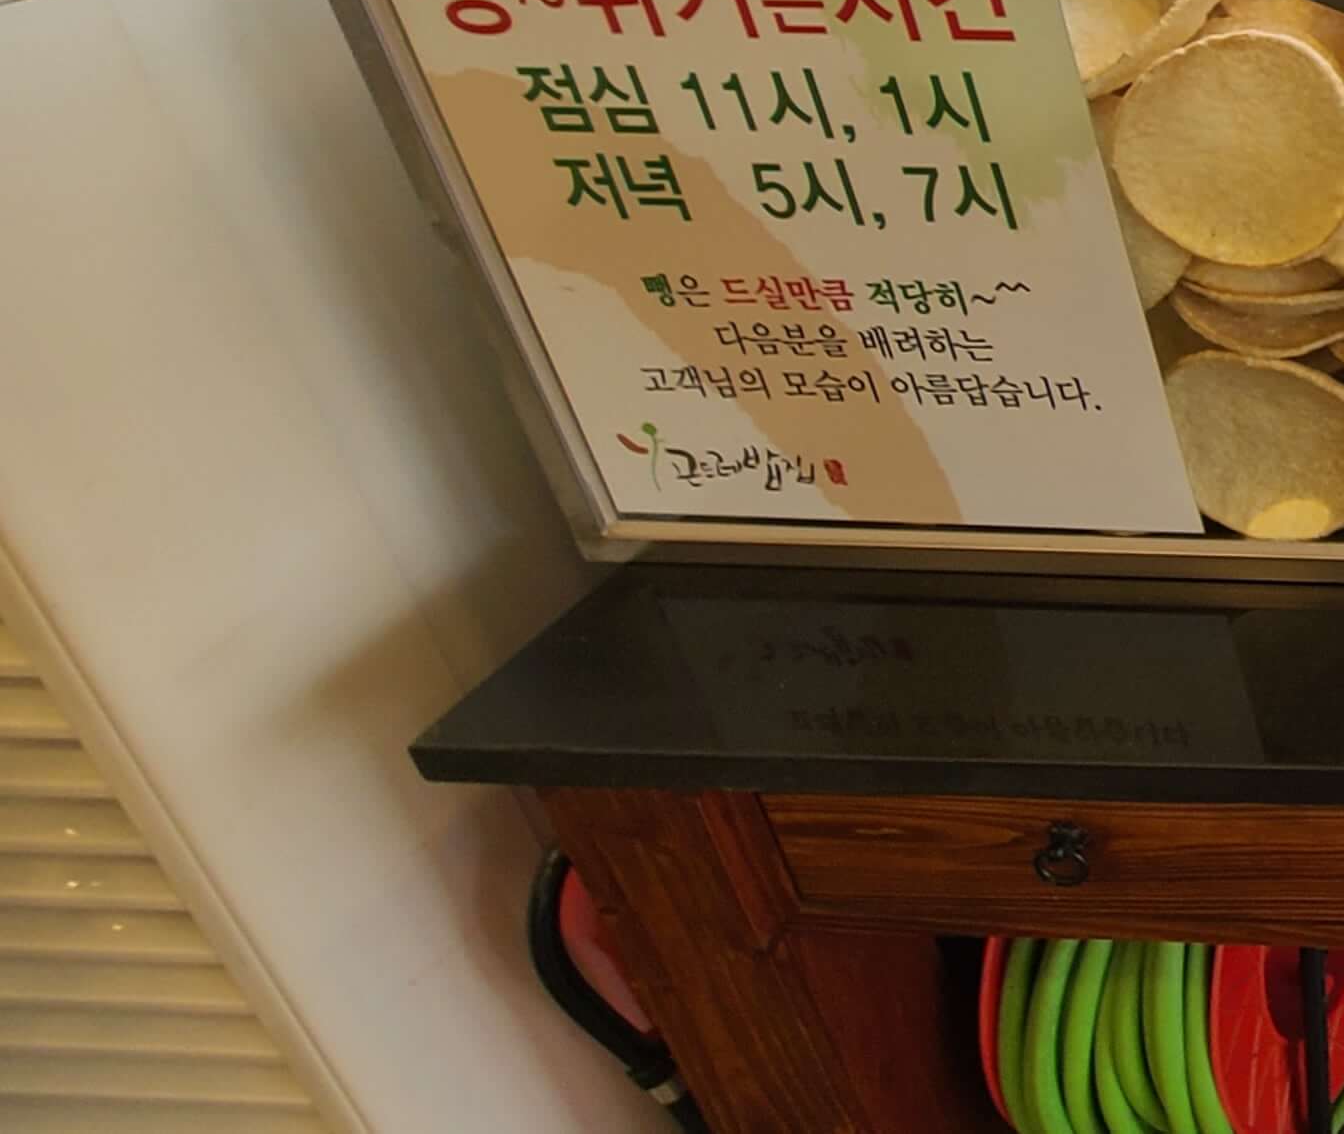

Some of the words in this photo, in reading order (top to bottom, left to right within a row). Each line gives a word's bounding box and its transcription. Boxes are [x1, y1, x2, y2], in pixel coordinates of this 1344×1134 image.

[518, 63, 661, 134] 점심
[681, 68, 857, 143] 11시,
[880, 71, 991, 143] 1시
[553, 153, 693, 221] 저녁
[752, 158, 886, 230] 5시,
[902, 162, 1018, 230] 7시
[720, 276, 855, 312] 드실만큼
[713, 321, 848, 358] 다음분을
[857, 325, 994, 362] 배려하는
[640, 365, 772, 400] 고객님의
[782, 370, 881, 403] 모습이
[890, 371, 1103, 411] 아름답습니다.
